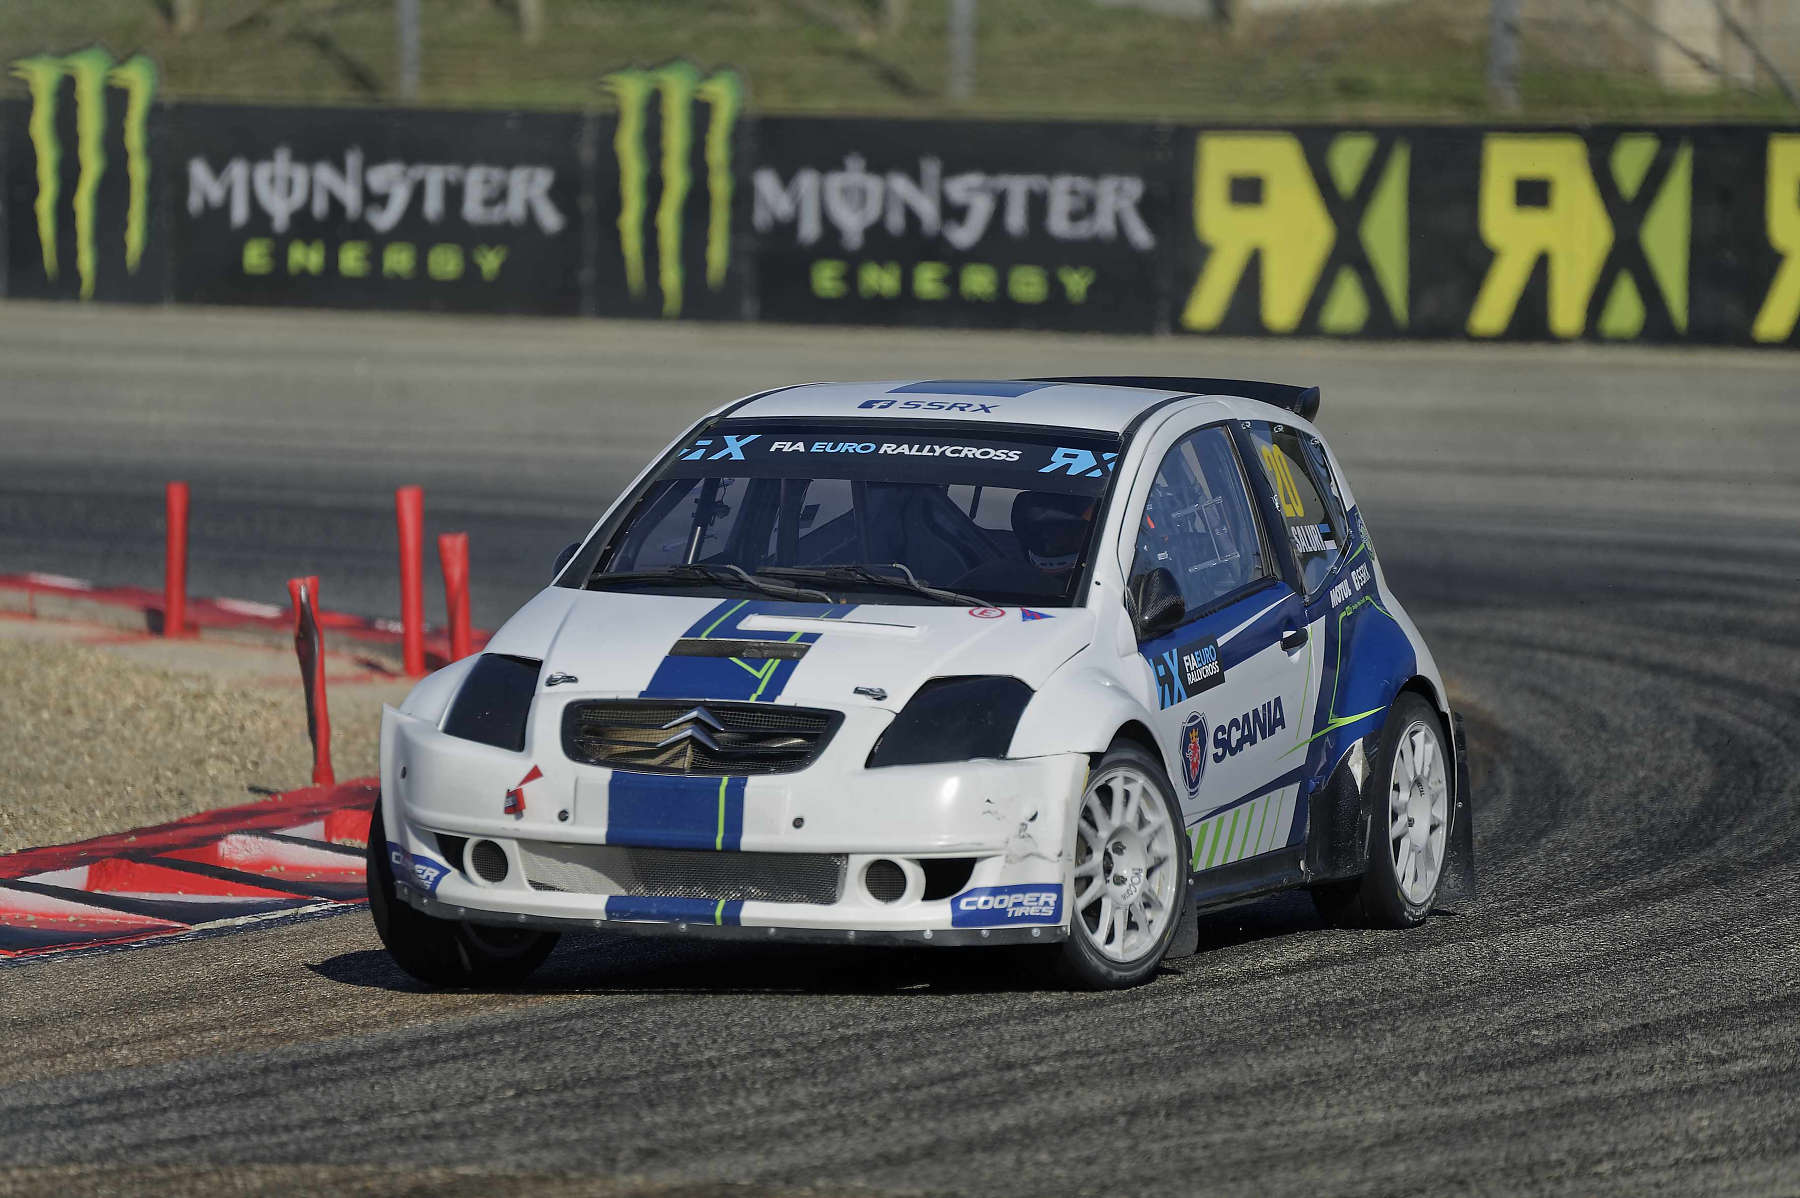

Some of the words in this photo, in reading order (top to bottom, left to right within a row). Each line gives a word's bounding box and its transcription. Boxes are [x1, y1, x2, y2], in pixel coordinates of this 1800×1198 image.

[187, 146, 565, 233] MONSTER
[753, 152, 1155, 250] MONSTER
[242, 237, 508, 281] ENERGY
[810, 259, 1096, 302] ENERGY
[898, 400, 1001, 414] SSRX
[769, 441, 805, 452] FIA
[810, 442, 877, 454] EURO
[878, 443, 1022, 462] RALLYCROSS
[1261, 444, 1305, 517] 20
[1329, 578, 1352, 609] MOTUL
[1186, 660, 1220, 686] RALLYCROSS
[1212, 695, 1286, 764] SCANIA
[960, 892, 1058, 911] COOPER
[1006, 906, 1055, 918] TIRES
